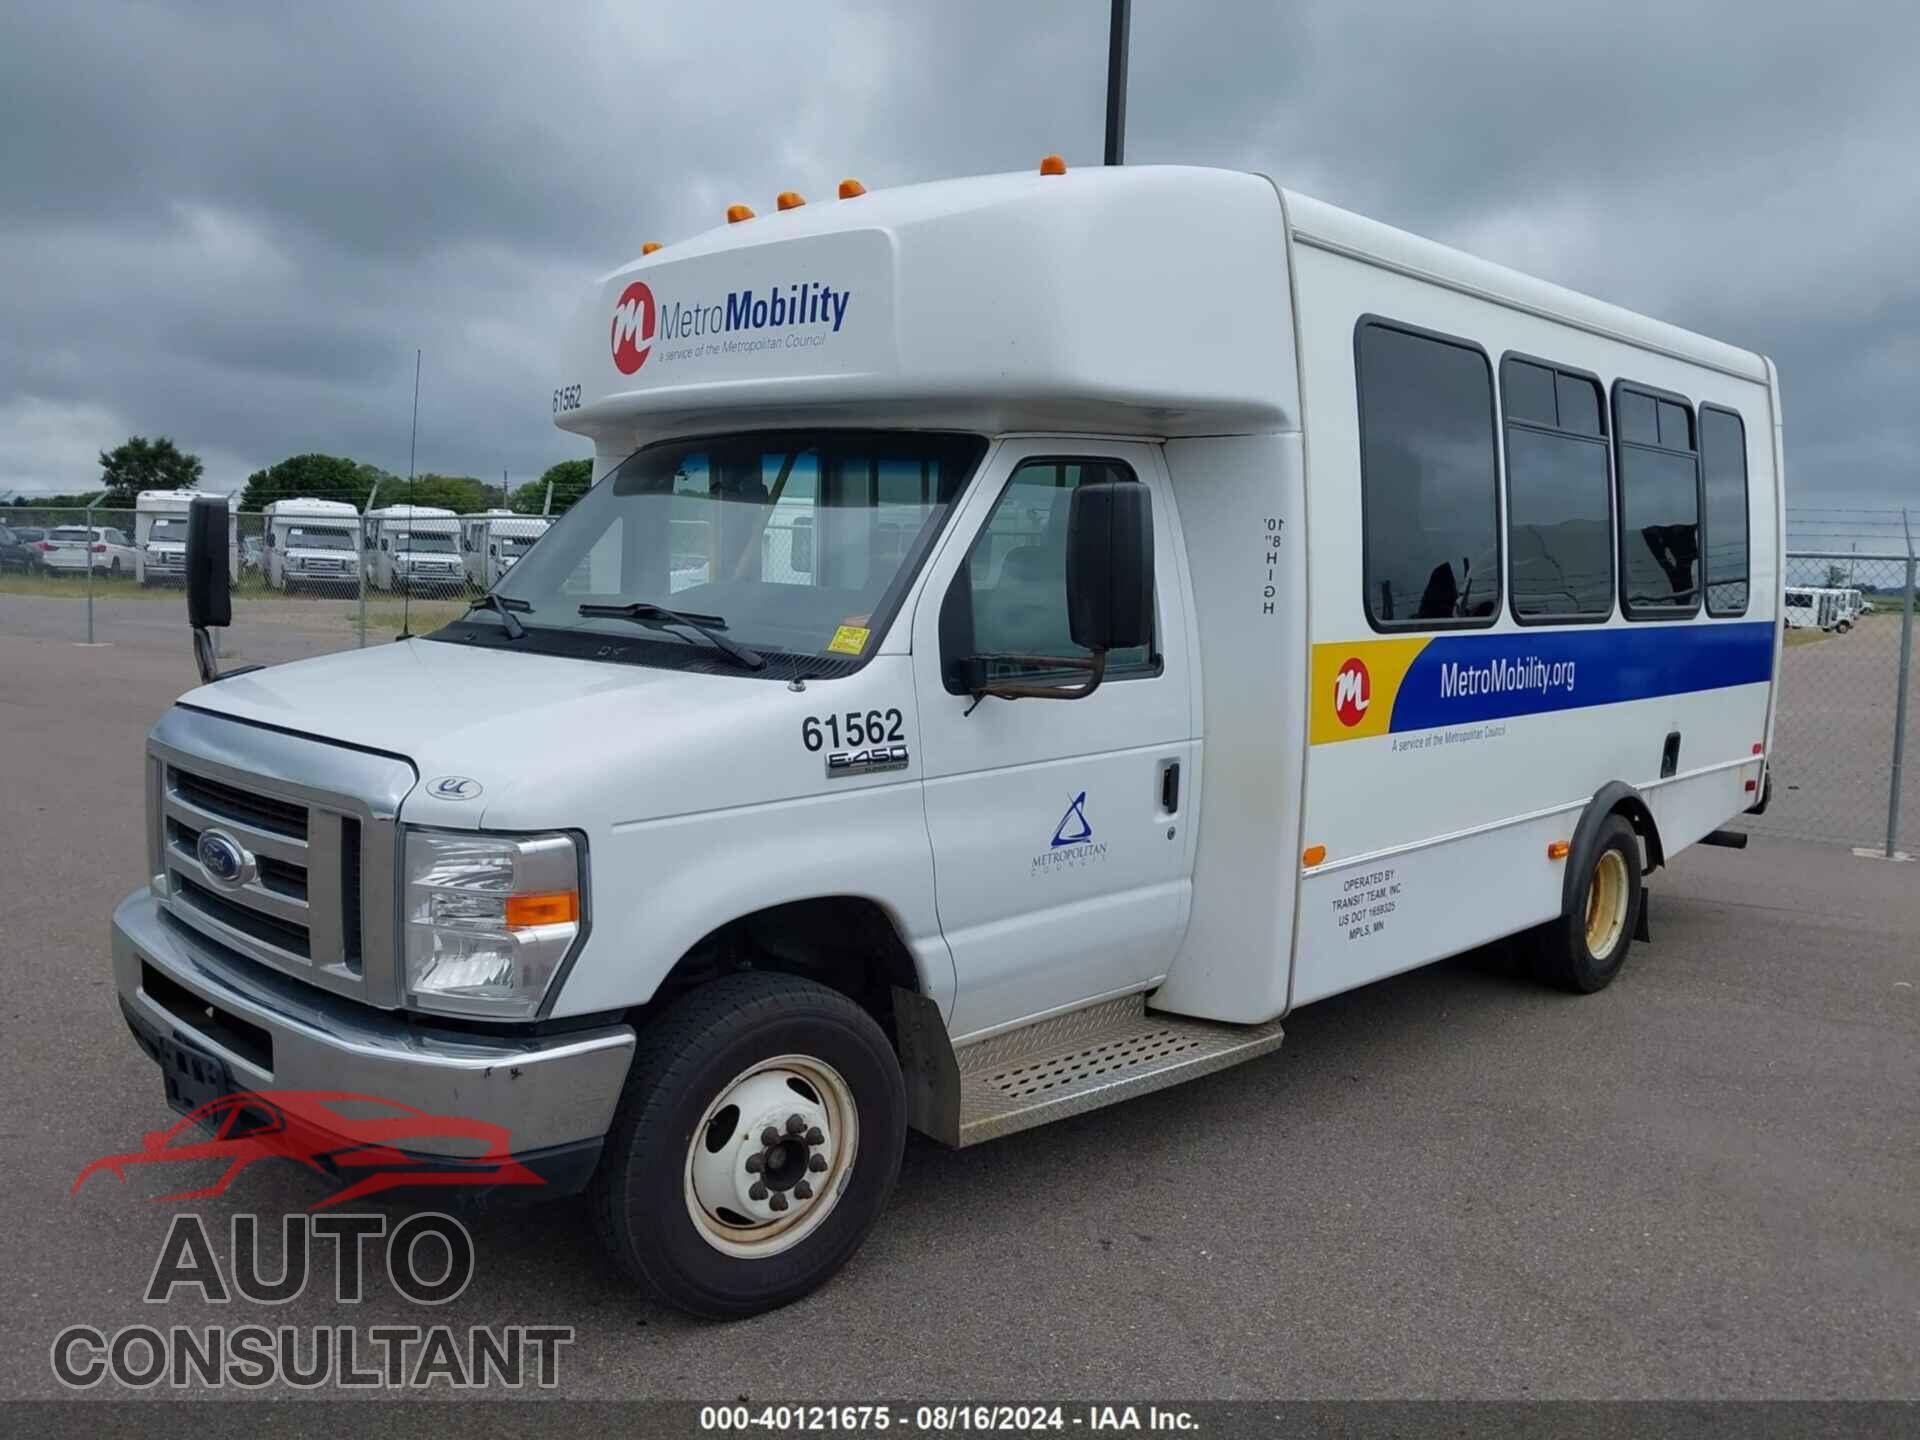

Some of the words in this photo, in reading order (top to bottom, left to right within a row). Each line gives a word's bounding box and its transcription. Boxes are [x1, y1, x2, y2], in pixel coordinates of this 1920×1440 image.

[660, 282, 850, 341] MetroMobility
[665, 348, 693, 360] service
[695, 345, 705, 357] of
[706, 343, 720, 355] the
[722, 338, 782, 353] Metropolitan
[785, 333, 826, 348] Council
[553, 384, 581, 413] 61562
[1440, 656, 1576, 698] MetroMobility.org
[802, 708, 904, 752] 61562
[1391, 737, 1398, 752] A
[1399, 737, 1423, 752] service
[1433, 733, 1444, 746] the
[1032, 842, 1108, 867] METROPOLITAN
[1344, 872, 1383, 892] OPERATED
[1385, 870, 1395, 881] BY
[1332, 893, 1364, 912] TRANSIT
[1338, 913, 1349, 927] US
[1351, 909, 1367, 923] DOT
